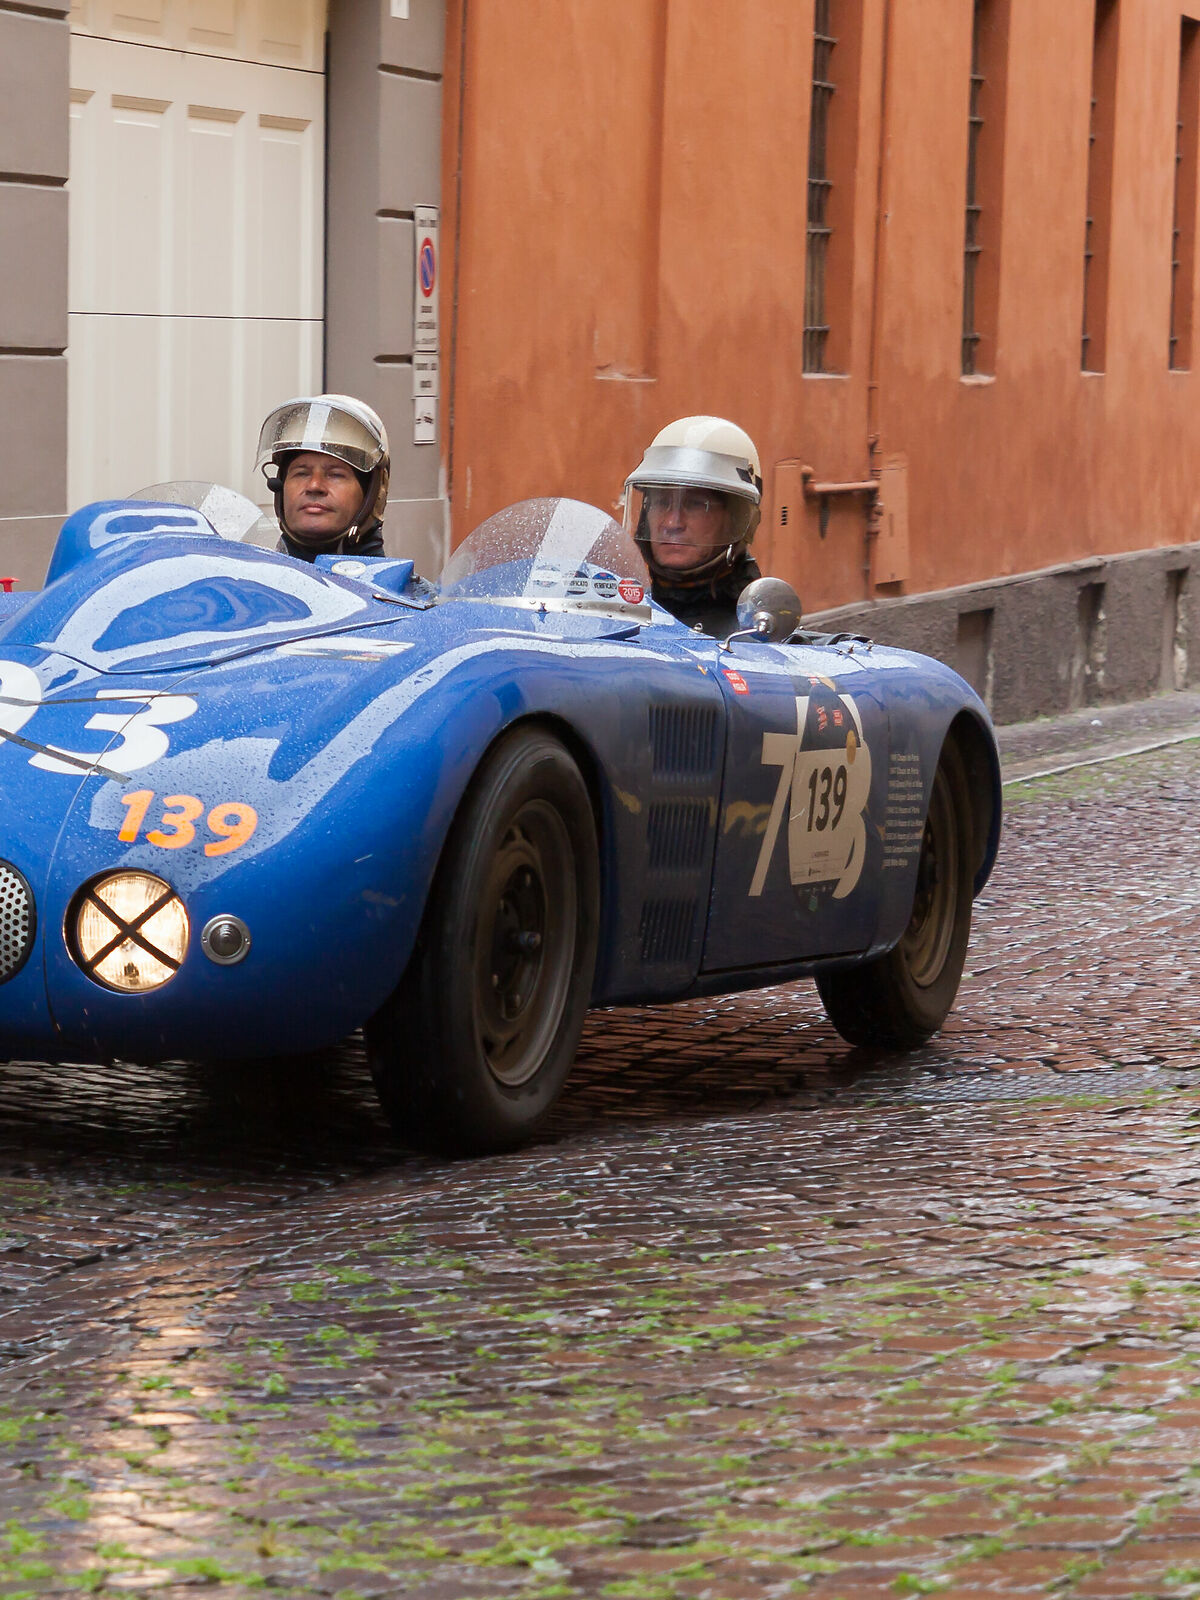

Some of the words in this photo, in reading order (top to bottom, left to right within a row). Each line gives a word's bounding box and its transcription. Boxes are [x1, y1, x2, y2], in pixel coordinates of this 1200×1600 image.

[622, 587, 640, 598] 2015
[117, 789, 259, 858] 139
[807, 764, 848, 833] 139
